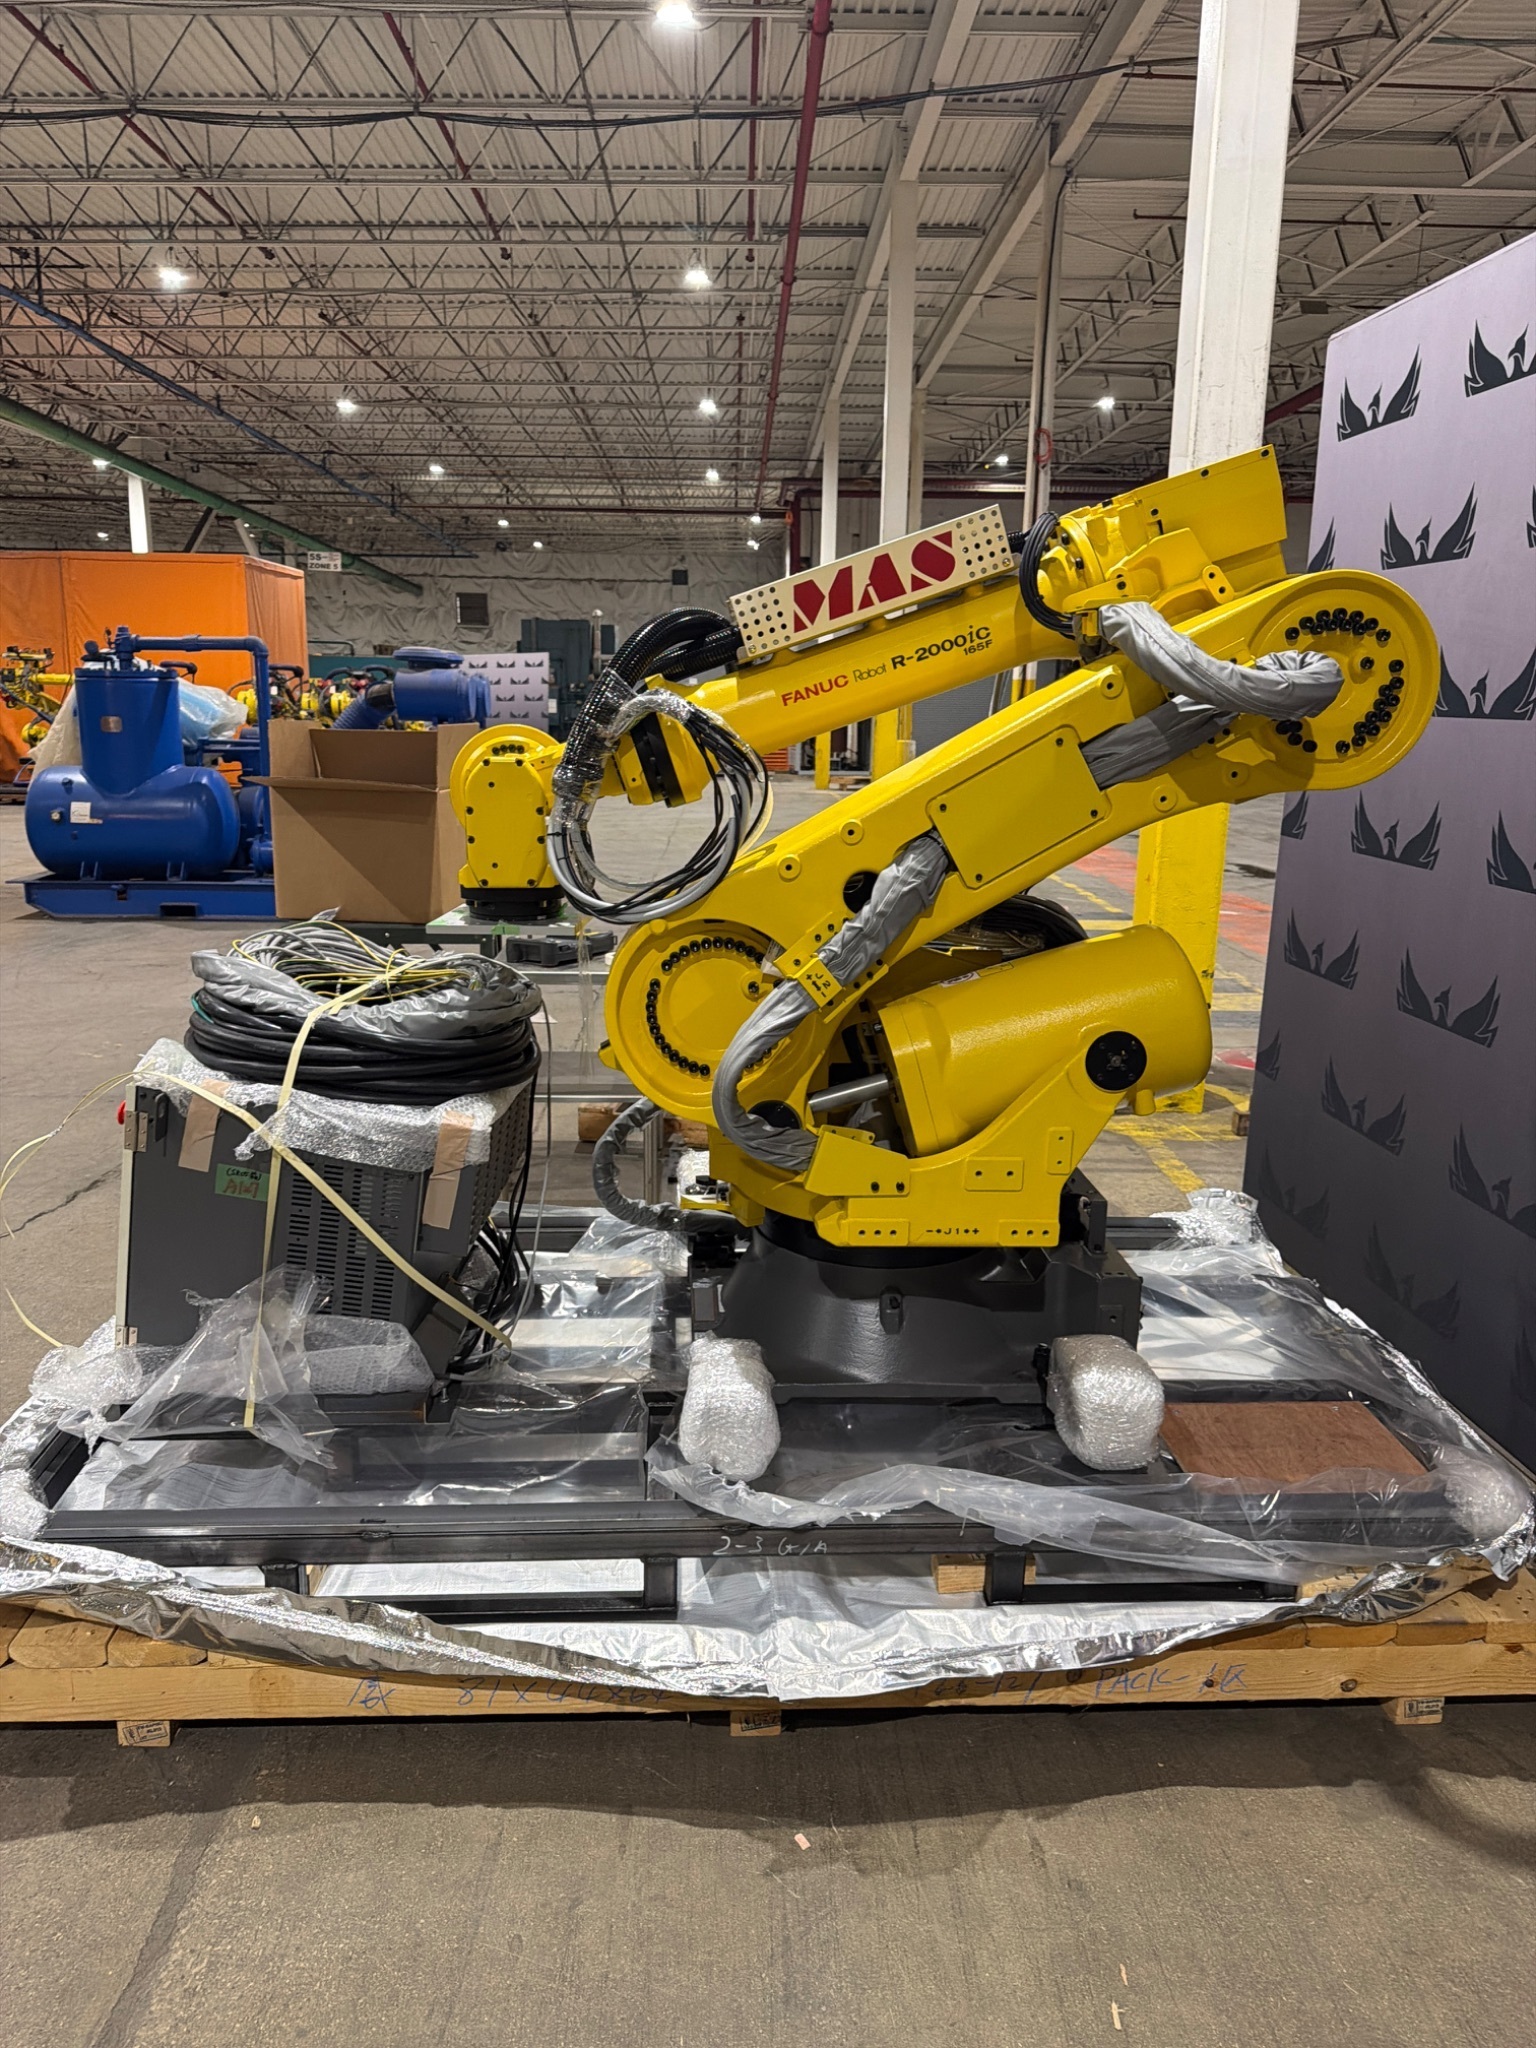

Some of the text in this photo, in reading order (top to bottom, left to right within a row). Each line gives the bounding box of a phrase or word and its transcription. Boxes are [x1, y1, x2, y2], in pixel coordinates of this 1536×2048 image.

[793, 530, 956, 634] MAS
[963, 639, 993, 656] 165F
[781, 674, 849, 706] FANUC
[853, 663, 887, 682] Robot
